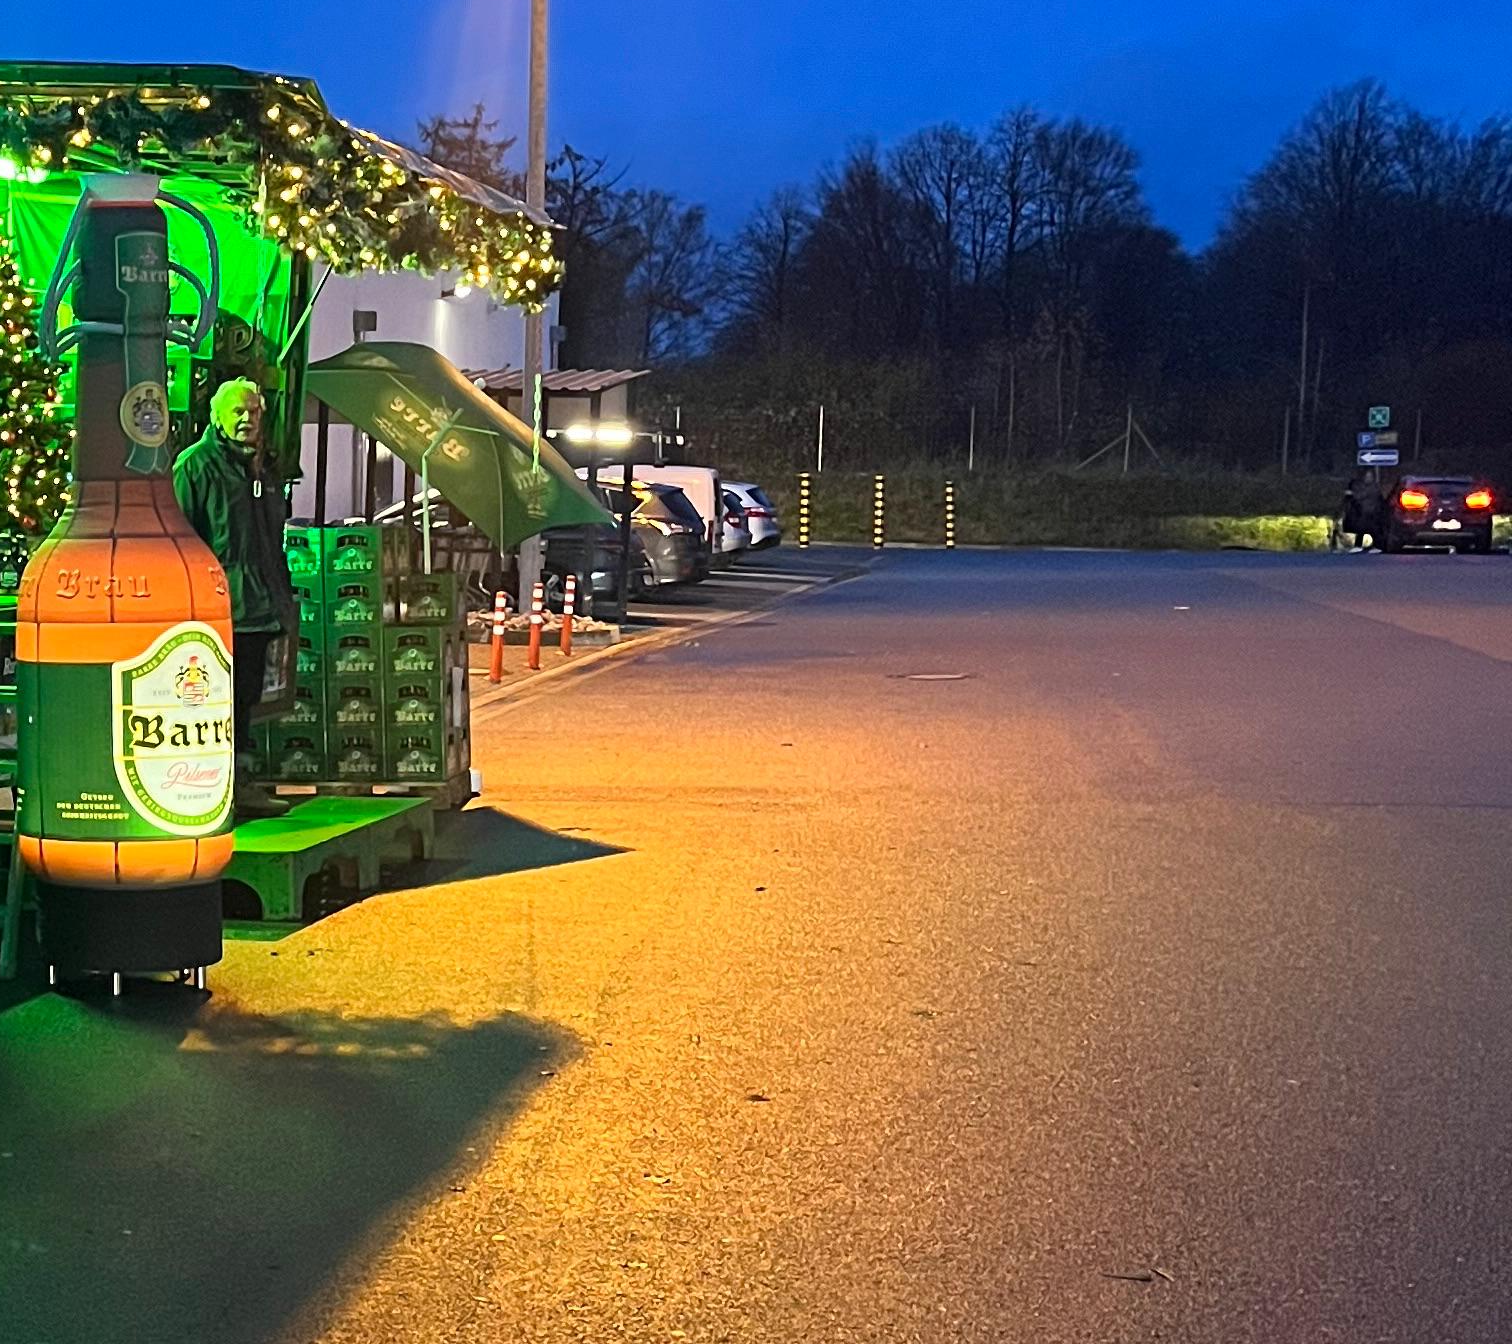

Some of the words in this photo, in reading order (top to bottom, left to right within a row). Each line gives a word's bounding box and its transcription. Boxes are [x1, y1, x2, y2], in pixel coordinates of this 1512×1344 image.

[121, 265, 168, 283] Barr
[333, 559, 373, 571] Barre
[334, 608, 374, 622] Barre
[335, 660, 375, 672] Barre
[393, 659, 434, 672] Barre
[336, 710, 376, 723] Barre
[395, 709, 435, 723] Barre
[396, 761, 436, 773] Barre
